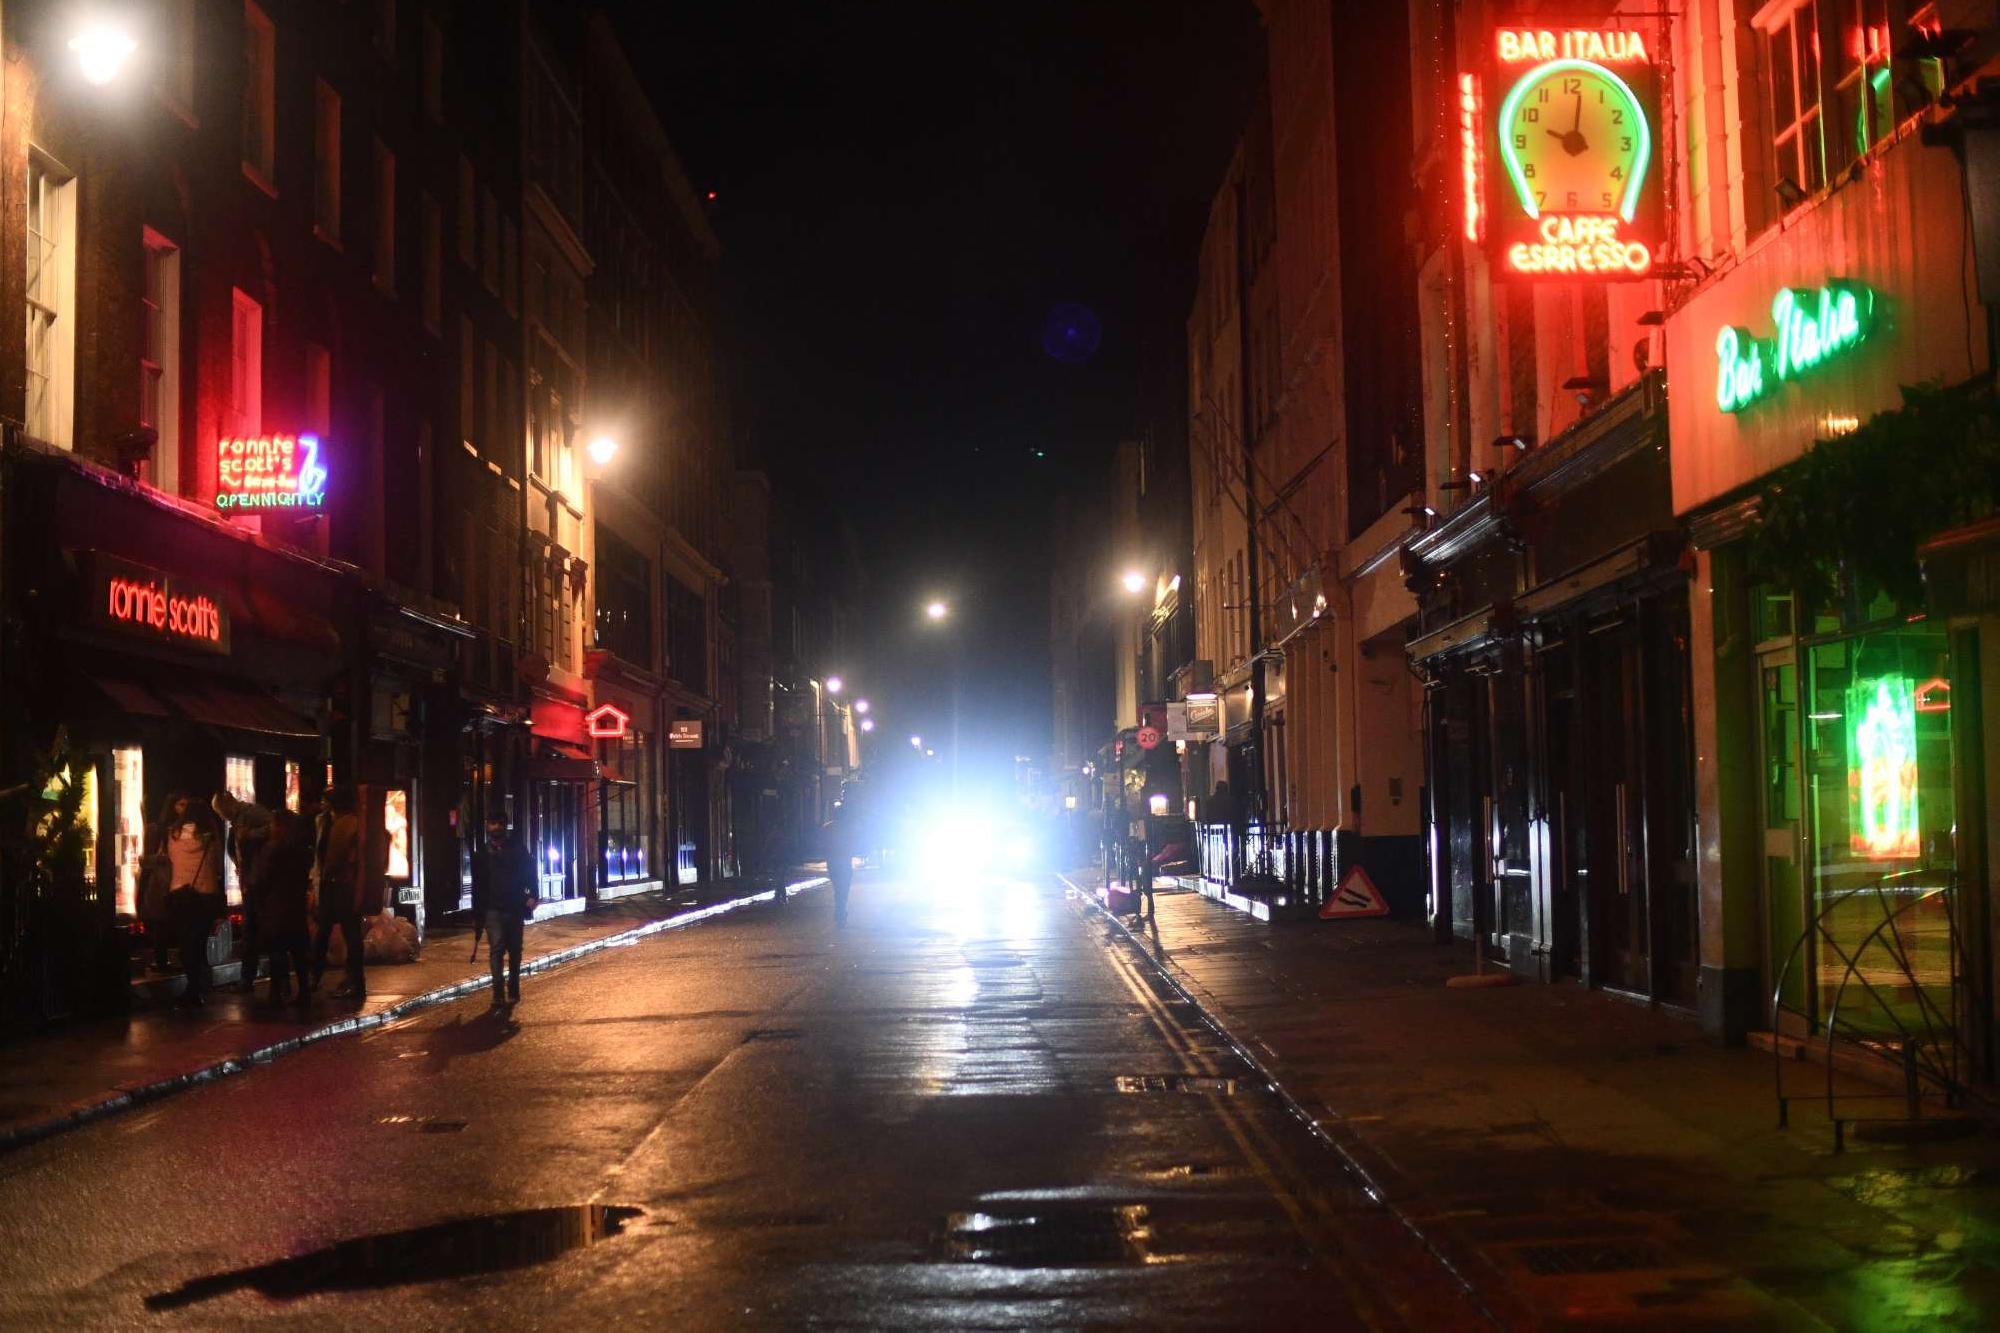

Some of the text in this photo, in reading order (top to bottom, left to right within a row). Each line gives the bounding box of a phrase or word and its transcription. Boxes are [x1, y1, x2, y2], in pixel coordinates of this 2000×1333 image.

[1498, 30, 1647, 61] BAR ITALIA
[1563, 79, 1581, 95] 12
[1539, 88, 1549, 103] 11
[1599, 89, 1604, 104] 1
[1522, 108, 1539, 123] 10
[1612, 110, 1623, 125] 2
[1516, 134, 1526, 150] 9
[1621, 136, 1632, 152] 3
[1524, 163, 1536, 179] 8
[1610, 165, 1623, 181] 4
[1536, 192, 1547, 208] 7
[1566, 192, 1578, 207] 6
[1602, 193, 1613, 208] 5
[1509, 243, 1650, 272] ESPRESSO
[1716, 287, 1860, 413] Bar Italia
[219, 438, 294, 456] ronnie
[219, 454, 293, 473] scott's
[108, 579, 166, 628] ronnie
[1141, 733, 1156, 742] 20
